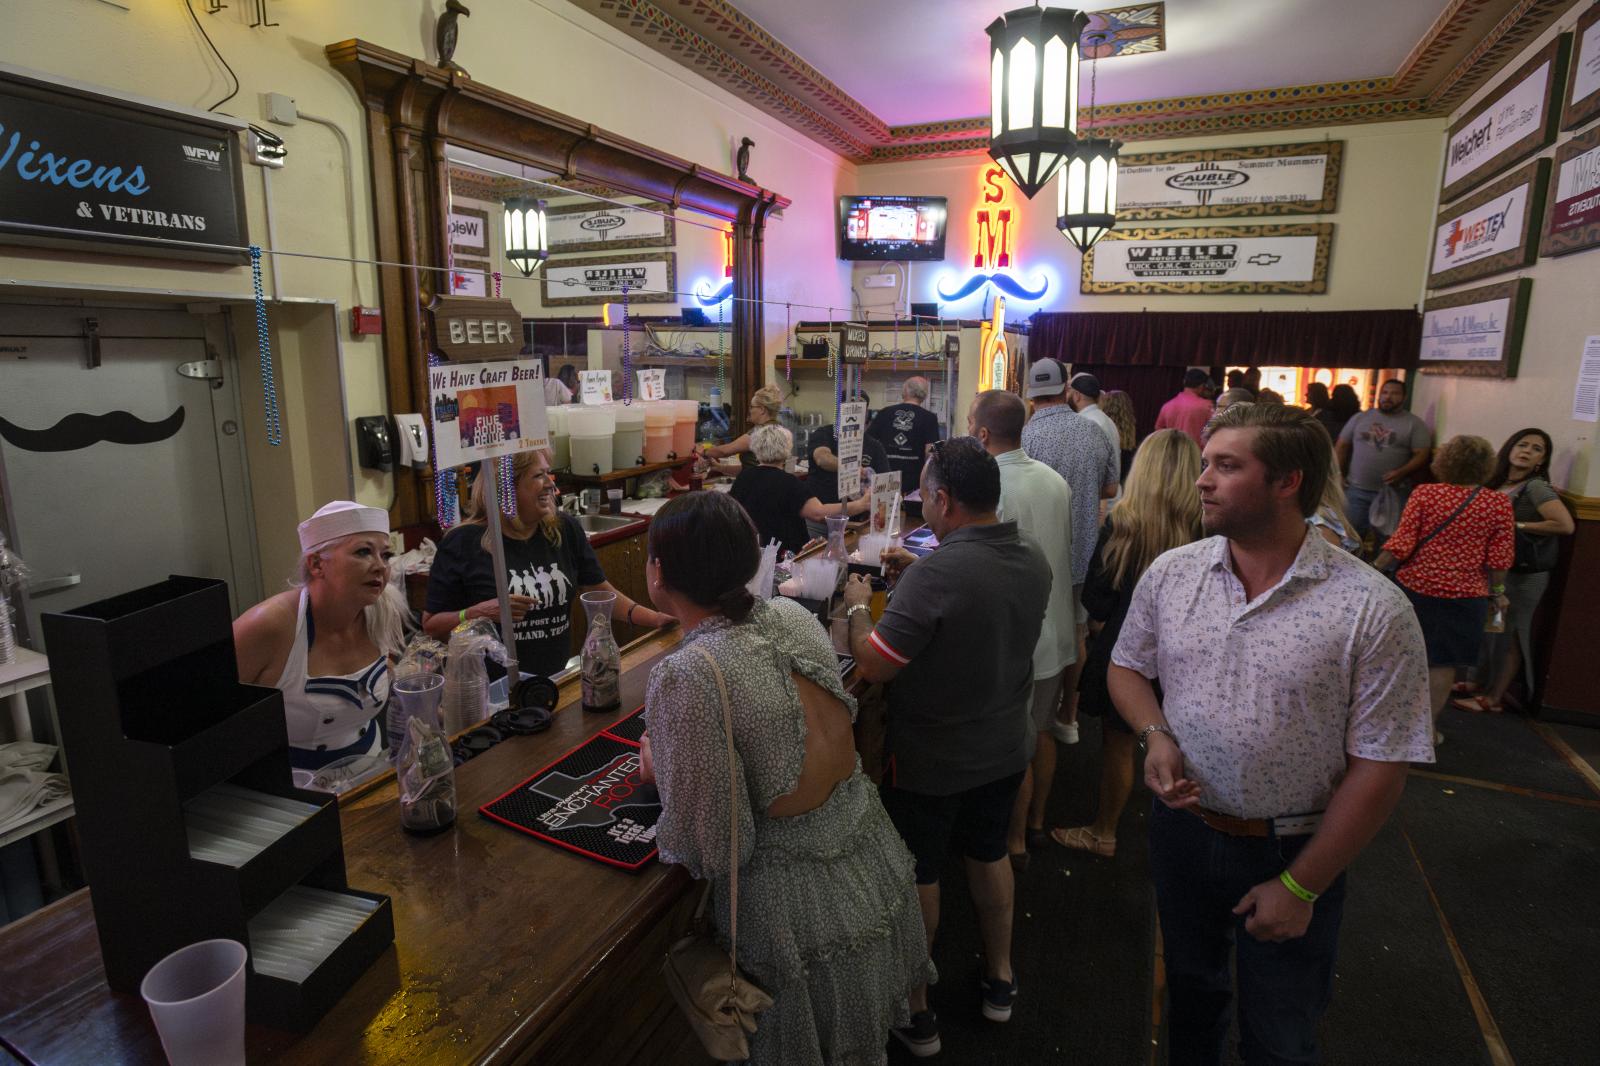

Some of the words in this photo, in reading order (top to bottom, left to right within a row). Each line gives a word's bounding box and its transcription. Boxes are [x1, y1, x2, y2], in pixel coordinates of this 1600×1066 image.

[1450, 116, 1493, 167] Weichert
[182, 145, 221, 162] VFW
[1277, 157, 1325, 167] Mummers
[1173, 173, 1237, 183] CAUBLE
[76, 200, 94, 219] &
[98, 203, 207, 232] VETERANS
[973, 207, 1015, 270] M
[1130, 245, 1235, 257] WHEELER
[1128, 262, 1151, 270] BUICK
[1190, 260, 1234, 269] CHEVROLET
[1188, 268, 1217, 276] TEXAS
[448, 319, 515, 345] BEER
[845, 344, 868, 358] DRINKS
[449, 370, 476, 388] HAVE
[479, 367, 508, 385] CRAFT
[511, 364, 541, 382] BEER!
[529, 617, 549, 627] POST
[512, 630, 549, 641] DLAND,
[543, 756, 640, 828] ENCHANTED
[591, 771, 641, 810] ROC
[536, 783, 590, 822] Ultra-Premium
[614, 823, 645, 845] Texas
